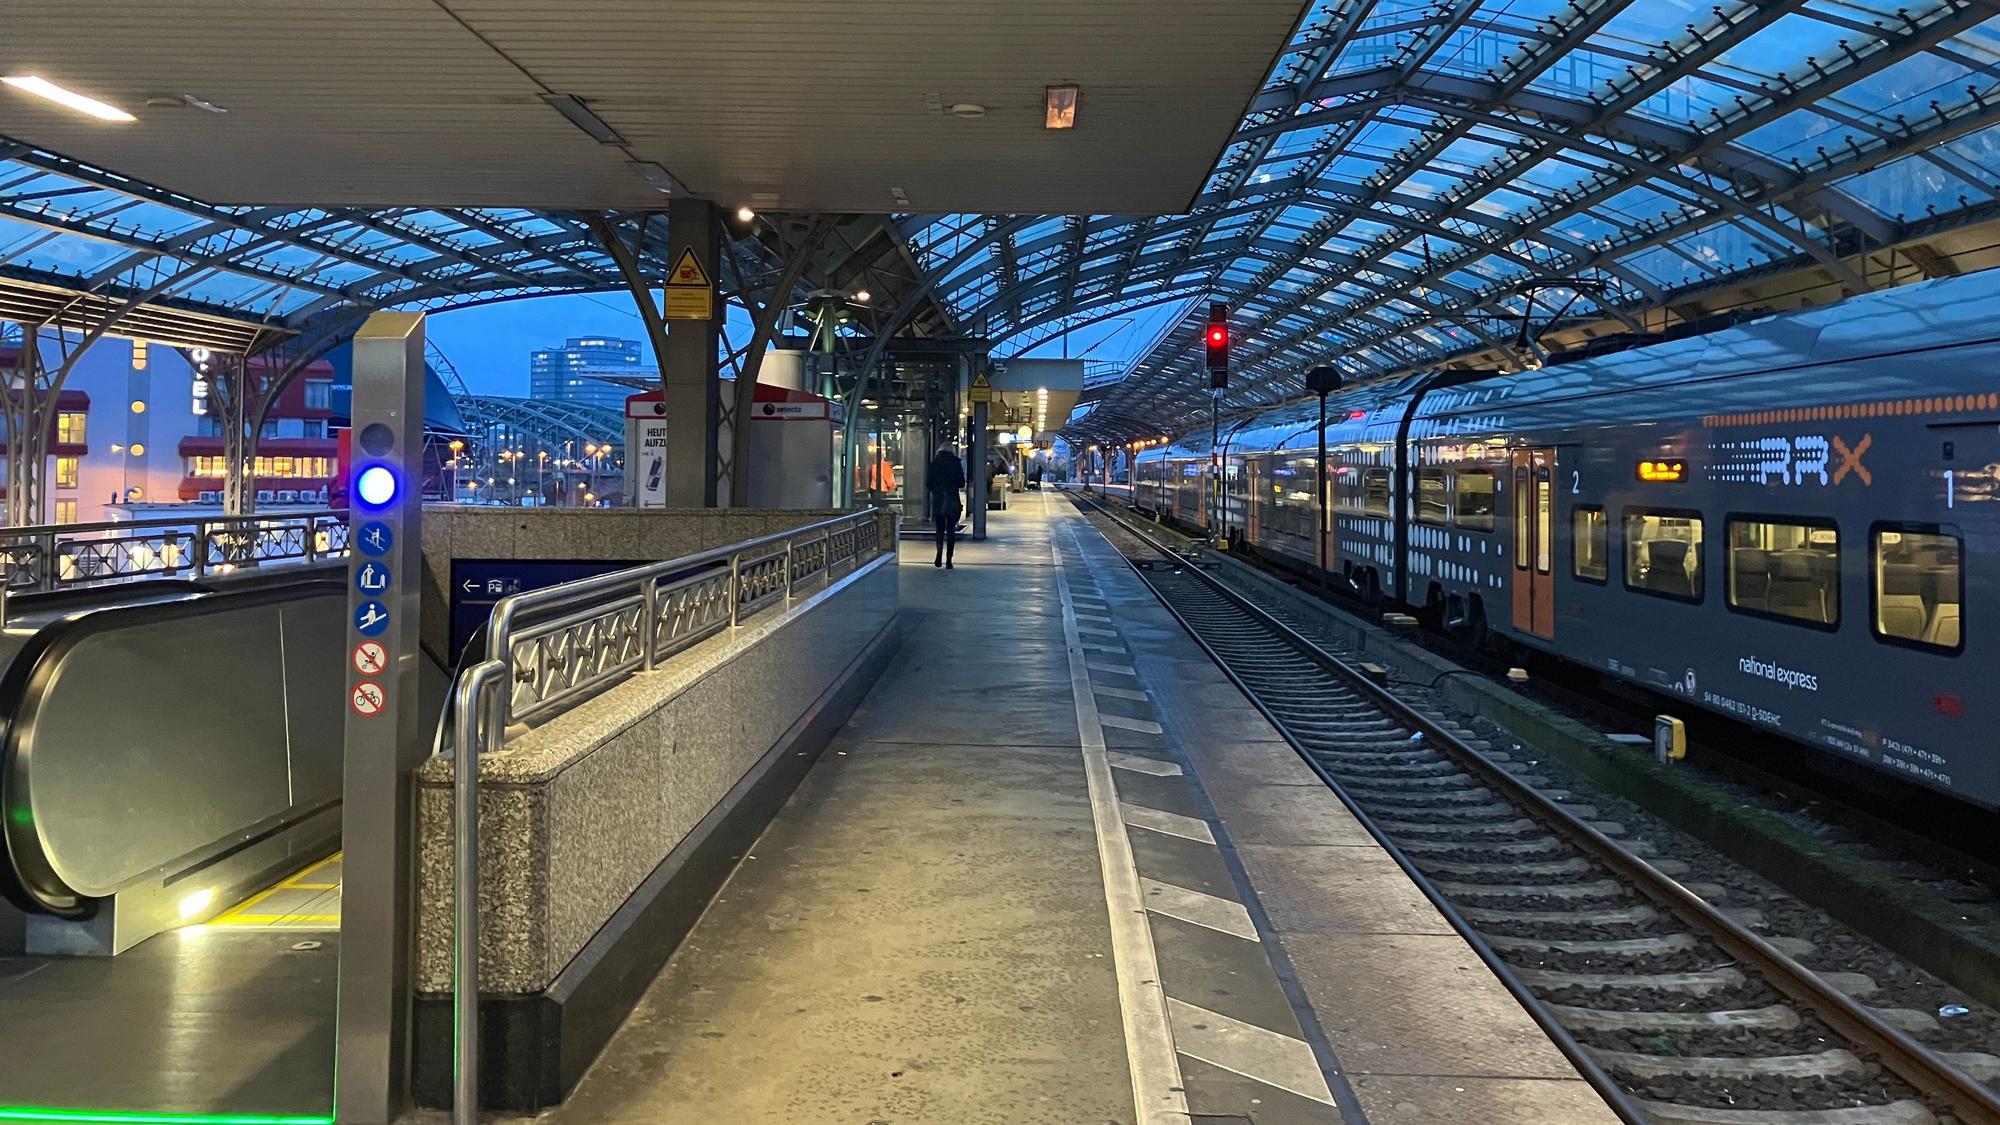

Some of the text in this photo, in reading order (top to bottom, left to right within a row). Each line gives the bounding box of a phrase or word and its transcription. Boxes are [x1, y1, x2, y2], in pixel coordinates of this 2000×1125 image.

[1760, 433, 1872, 486] RRX
[1572, 470, 1580, 494] 2
[1943, 470, 1953, 509] 1
[1739, 655, 1818, 691] national express
